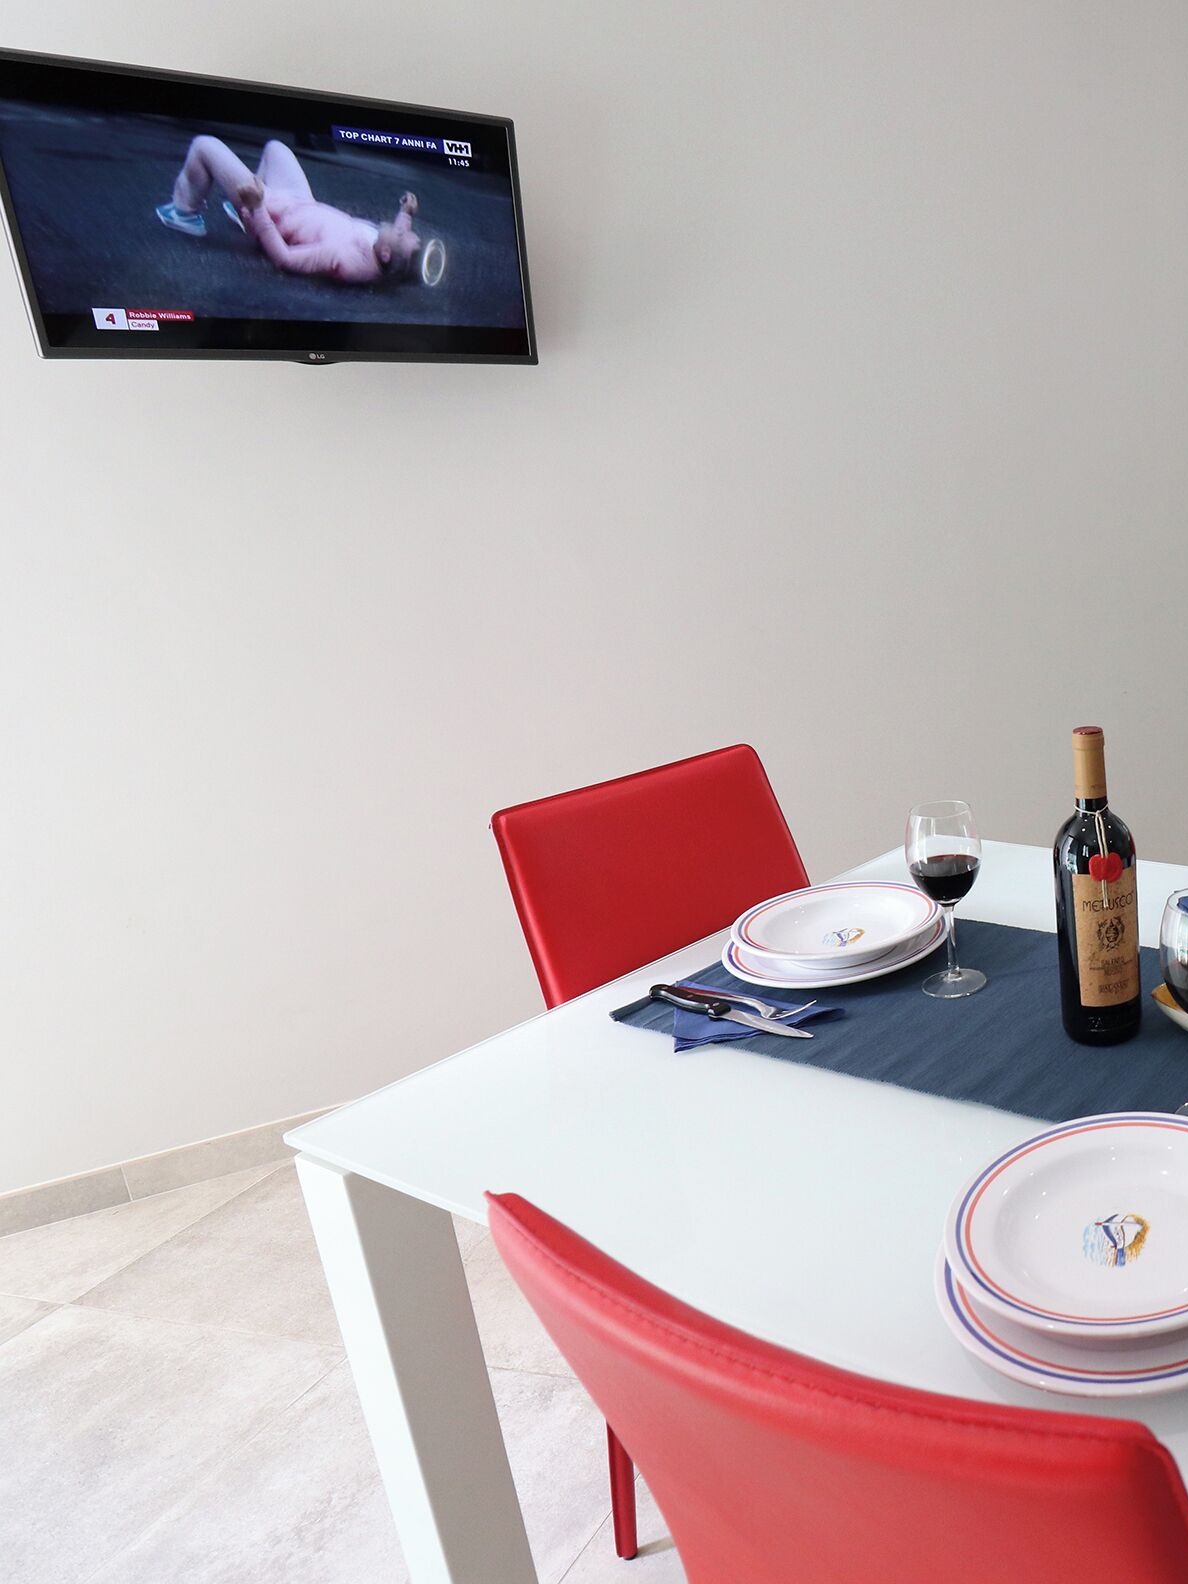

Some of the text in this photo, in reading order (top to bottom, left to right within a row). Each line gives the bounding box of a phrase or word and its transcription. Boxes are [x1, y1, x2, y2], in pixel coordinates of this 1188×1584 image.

[339, 130, 437, 150] TOP CHART 7 ANNI FA
[448, 157, 470, 167] 11:45
[105, 313, 116, 325] 4
[129, 311, 191, 320] Robbie Williams
[131, 321, 155, 329] Candy
